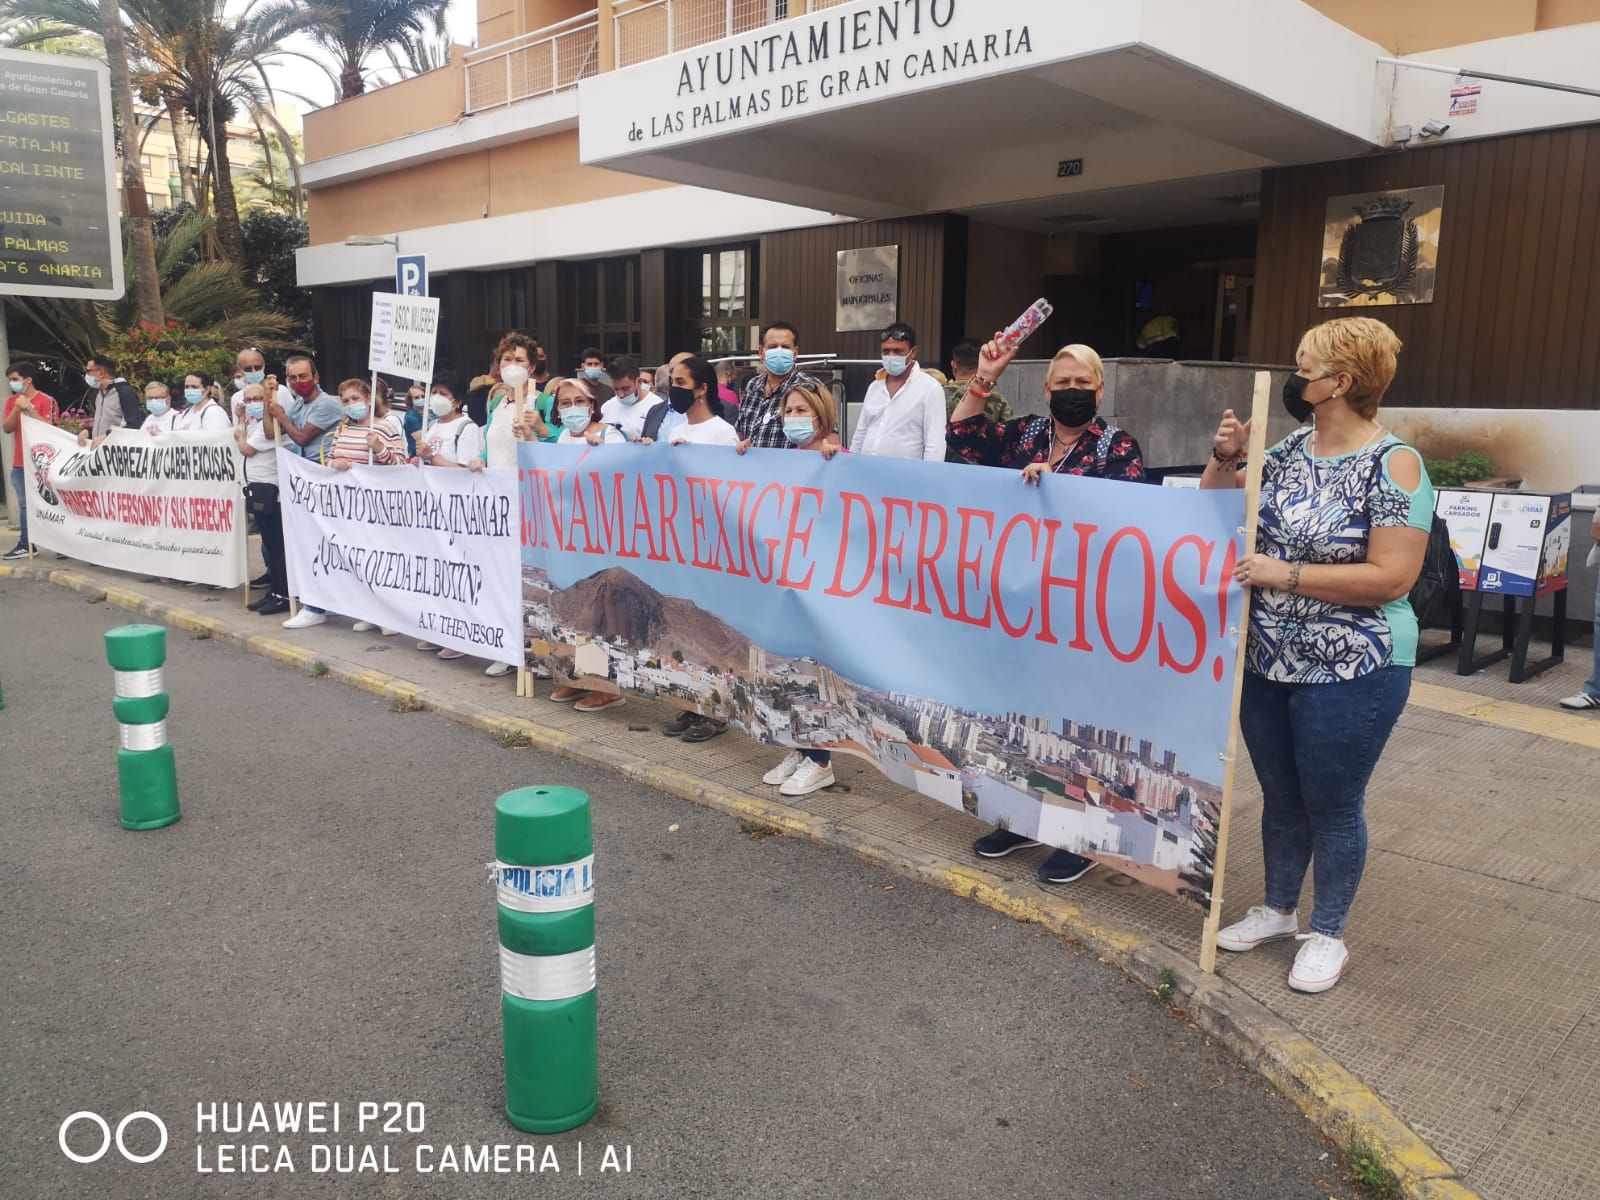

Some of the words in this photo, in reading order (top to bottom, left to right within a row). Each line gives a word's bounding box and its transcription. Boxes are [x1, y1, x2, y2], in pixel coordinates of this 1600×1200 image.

[677, 0, 955, 95] AYUNTAMIENTO
[4, 71, 73, 87] Ayuntamiento
[74, 79, 88, 89] de
[8, 82, 21, 91] de
[23, 83, 48, 95] Gran
[50, 87, 89, 100] Canaria
[628, 122, 644, 142] de
[651, 110, 685, 138] LAS
[692, 89, 772, 128] PALMAS
[781, 80, 809, 109] DE
[820, 58, 891, 99] GRAN
[903, 25, 1034, 80] CANARIA
[1060, 161, 1080, 175] 270
[4, 236, 70, 253] PALMAS
[849, 273, 884, 284] OFICINAS
[841, 293, 892, 305] MUNICIPALES
[89, 446, 105, 476] LA
[102, 445, 149, 480] POBREZA
[164, 446, 191, 480] CABEN
[192, 445, 236, 481] EXCUSAS
[100, 491, 117, 520] LAS
[117, 492, 163, 527] PERSONAS
[170, 496, 188, 529] SUS
[320, 483, 365, 521] TANTO
[365, 489, 413, 526] DINERO
[414, 490, 450, 532] PARA
[448, 483, 511, 546] JINÁMAR
[1444, 510, 1481, 518] CARGADOR
[365, 550, 411, 593] QUEDA
[416, 556, 431, 594] EL
[518, 447, 686, 565] ¡JINÁMAR
[685, 477, 824, 590] EXIGE
[824, 492, 1237, 683] DERECHOS!
[439, 616, 504, 649] THENESOR
